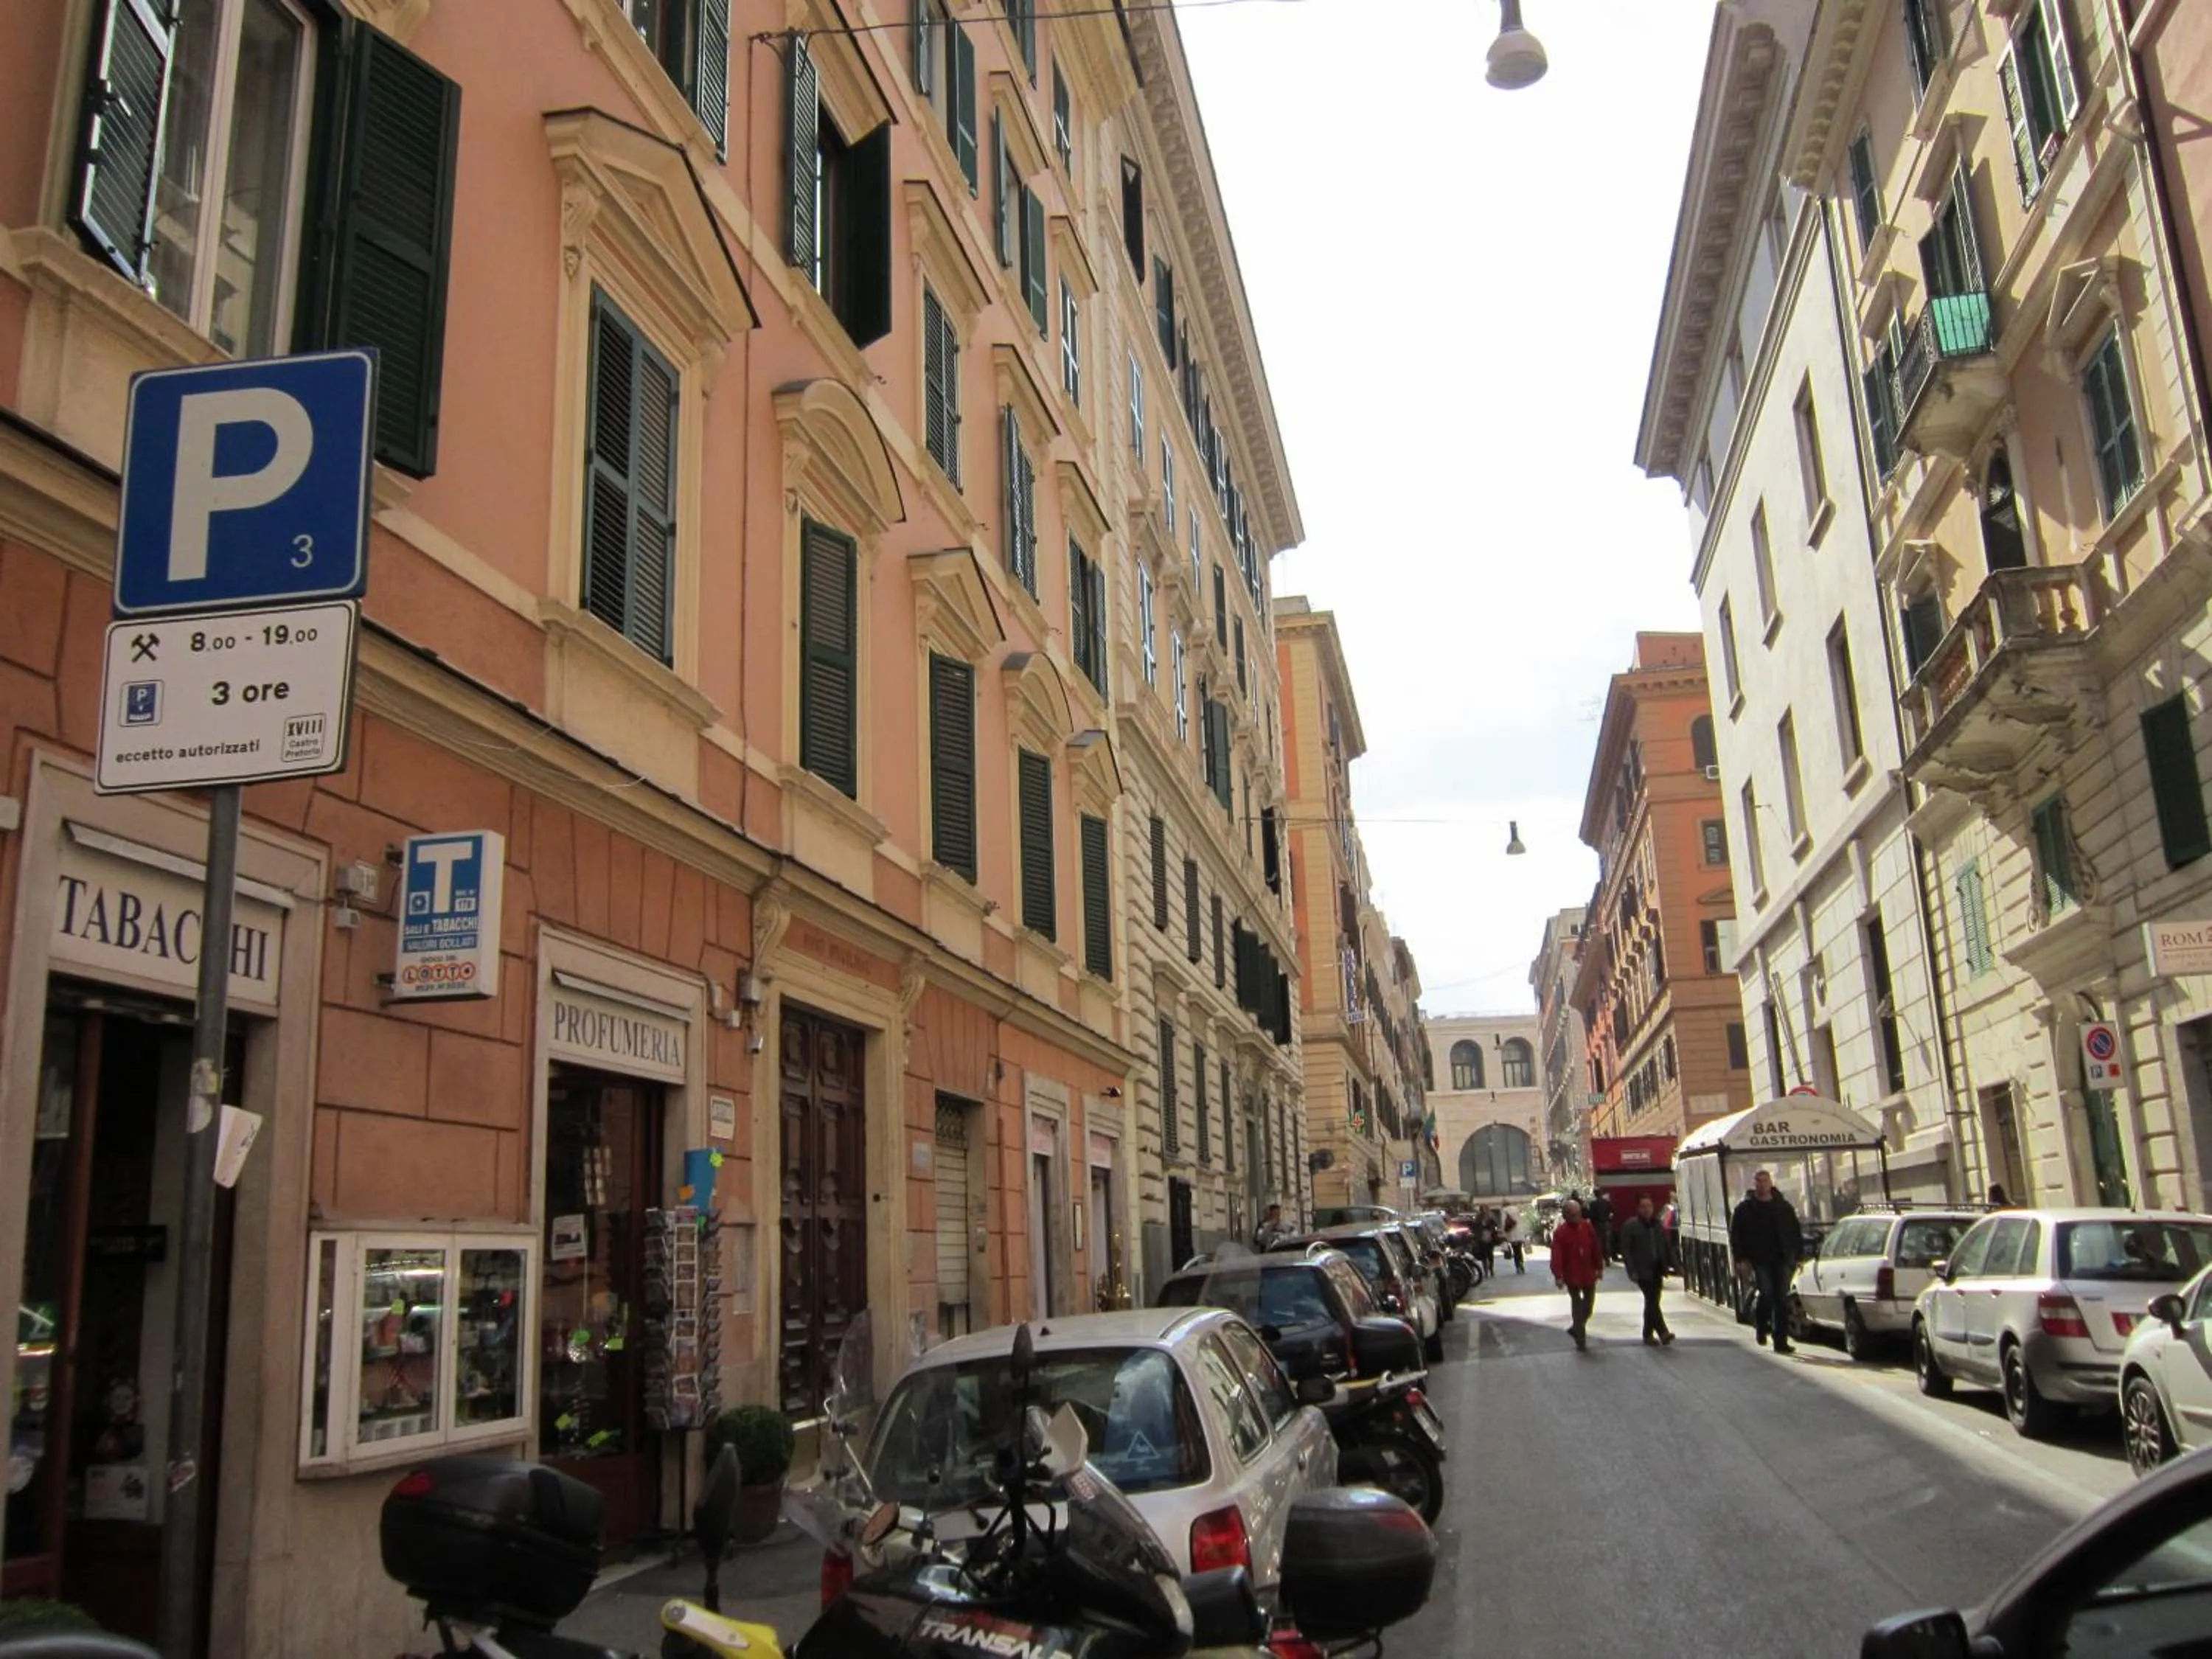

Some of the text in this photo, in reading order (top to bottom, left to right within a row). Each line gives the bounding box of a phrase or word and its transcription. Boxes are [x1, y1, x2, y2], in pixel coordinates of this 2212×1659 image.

[167, 386, 314, 582] P
[290, 534, 314, 569] 3
[189, 631, 236, 653] 8.00
[262, 625, 318, 646] 19.00
[211, 681, 290, 706] 3 ore
[287, 719, 323, 737] XVIII
[115, 739, 260, 763] eccetto autorizzati
[417, 841, 473, 914] T
[58, 874, 269, 982] TABACHI
[431, 915, 479, 933] TABACCHI
[403, 961, 476, 984] LOTTO
[554, 1000, 681, 1067] PROFUMERIA
[1749, 1133, 1857, 1147] GASTRONOMIA
[1752, 1121, 1791, 1135] BAR
